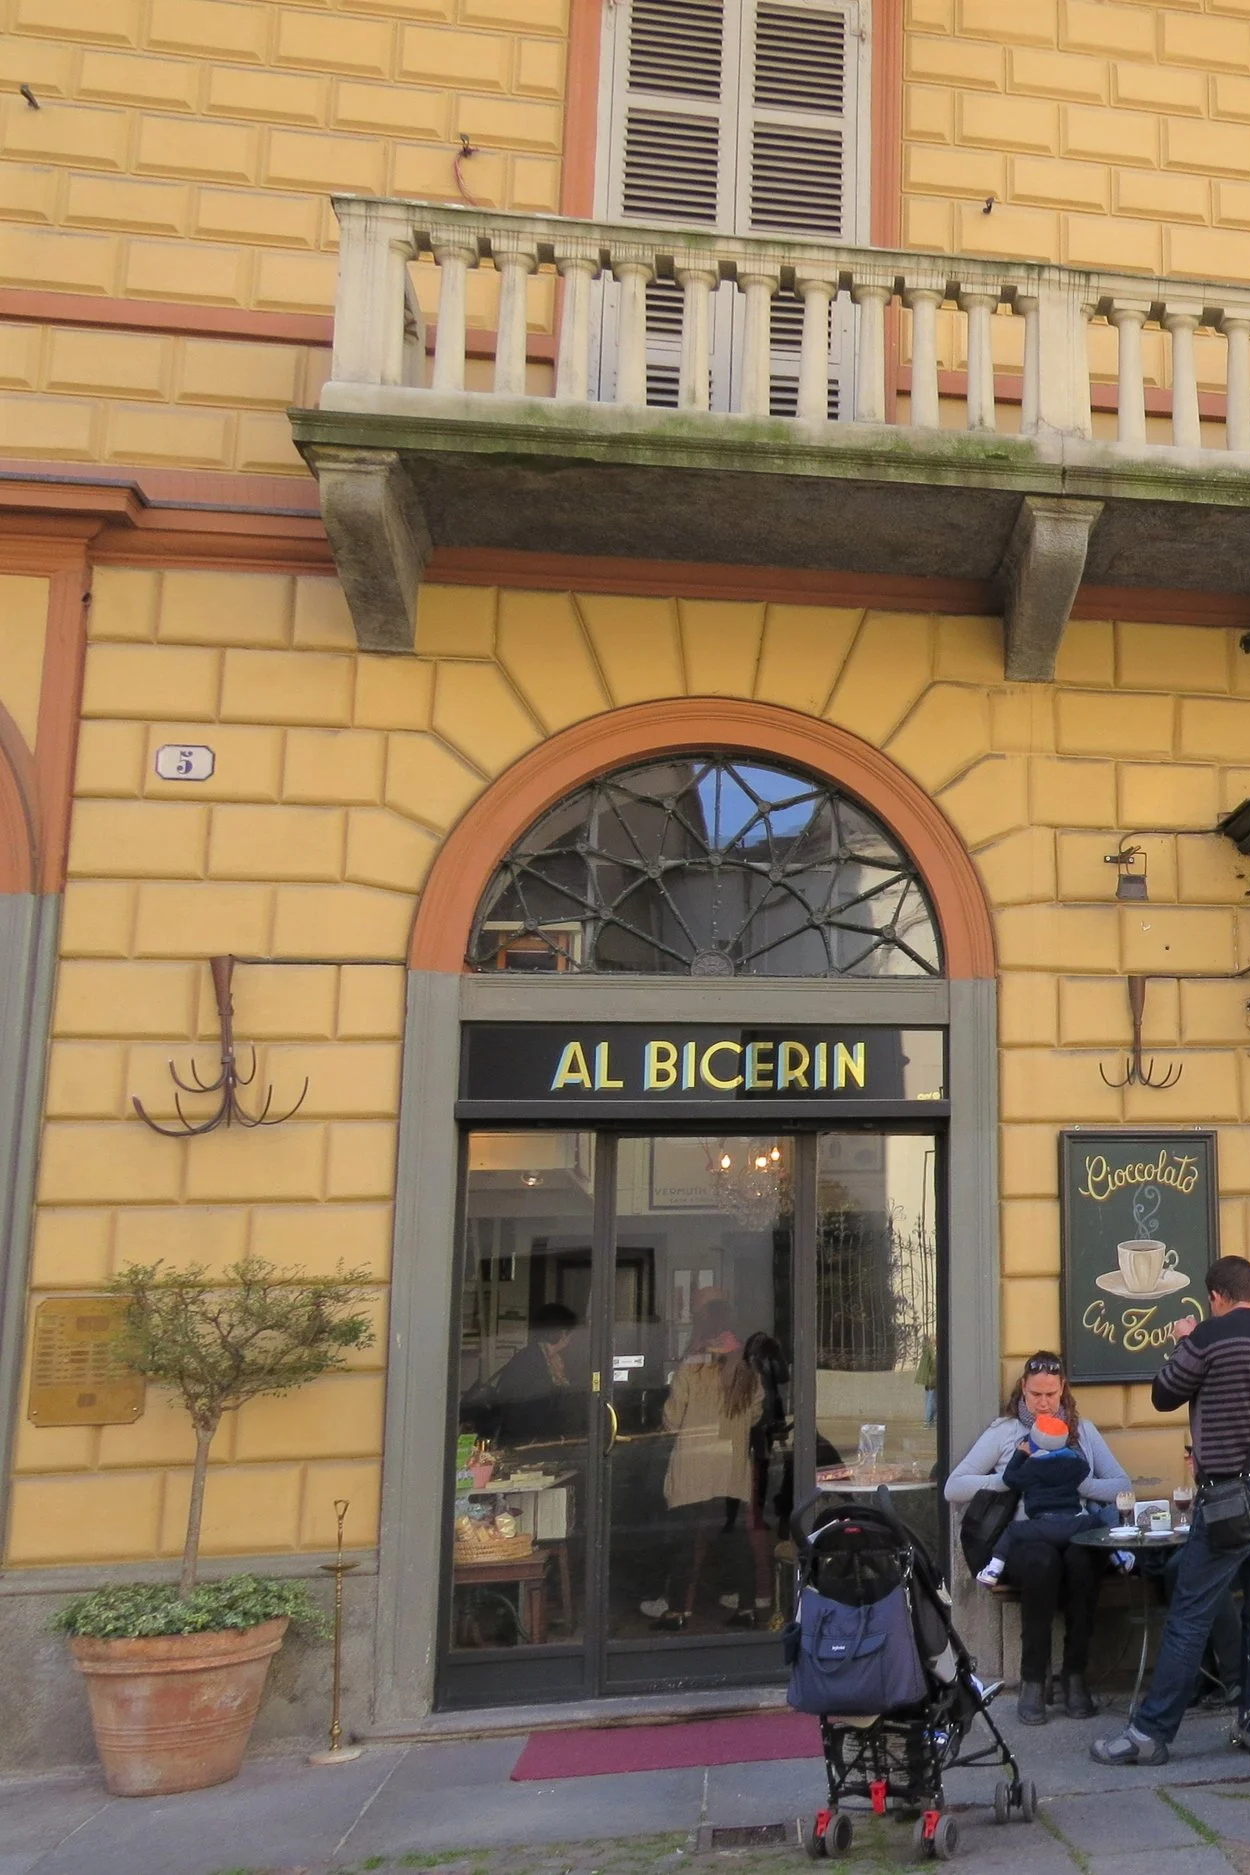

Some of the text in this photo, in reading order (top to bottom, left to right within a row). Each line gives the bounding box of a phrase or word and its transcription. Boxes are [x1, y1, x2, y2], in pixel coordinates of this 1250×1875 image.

[177, 750, 193, 774] 5
[550, 1040, 866, 1092] AL BICERIN
[1079, 1149, 1198, 1200] Cioccolato
